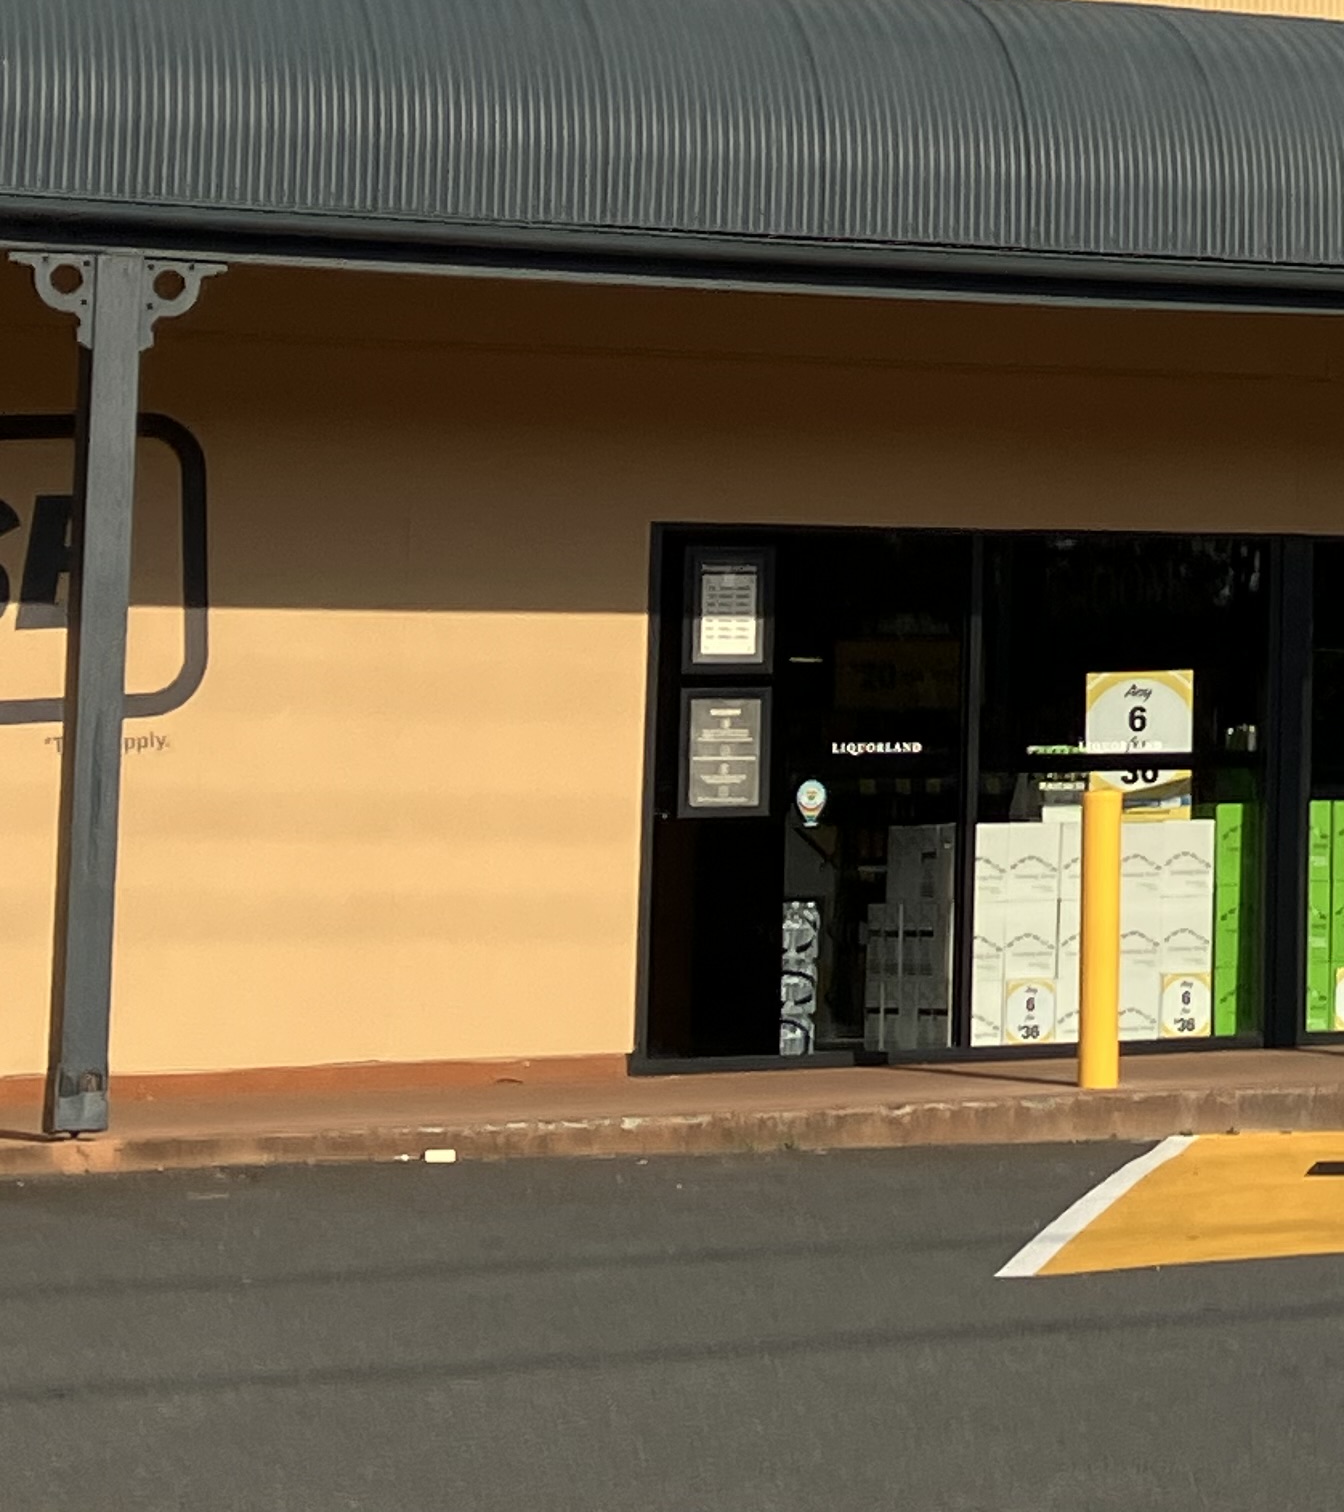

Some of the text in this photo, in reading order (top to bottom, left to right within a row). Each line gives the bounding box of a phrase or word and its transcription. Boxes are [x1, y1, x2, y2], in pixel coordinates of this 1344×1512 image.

[1128, 706, 1147, 732] 6
[124, 731, 170, 755] pply.
[831, 741, 923, 756] LIQUORLAND
[1026, 997, 1036, 1012] 6
[1181, 990, 1191, 1005] 6
